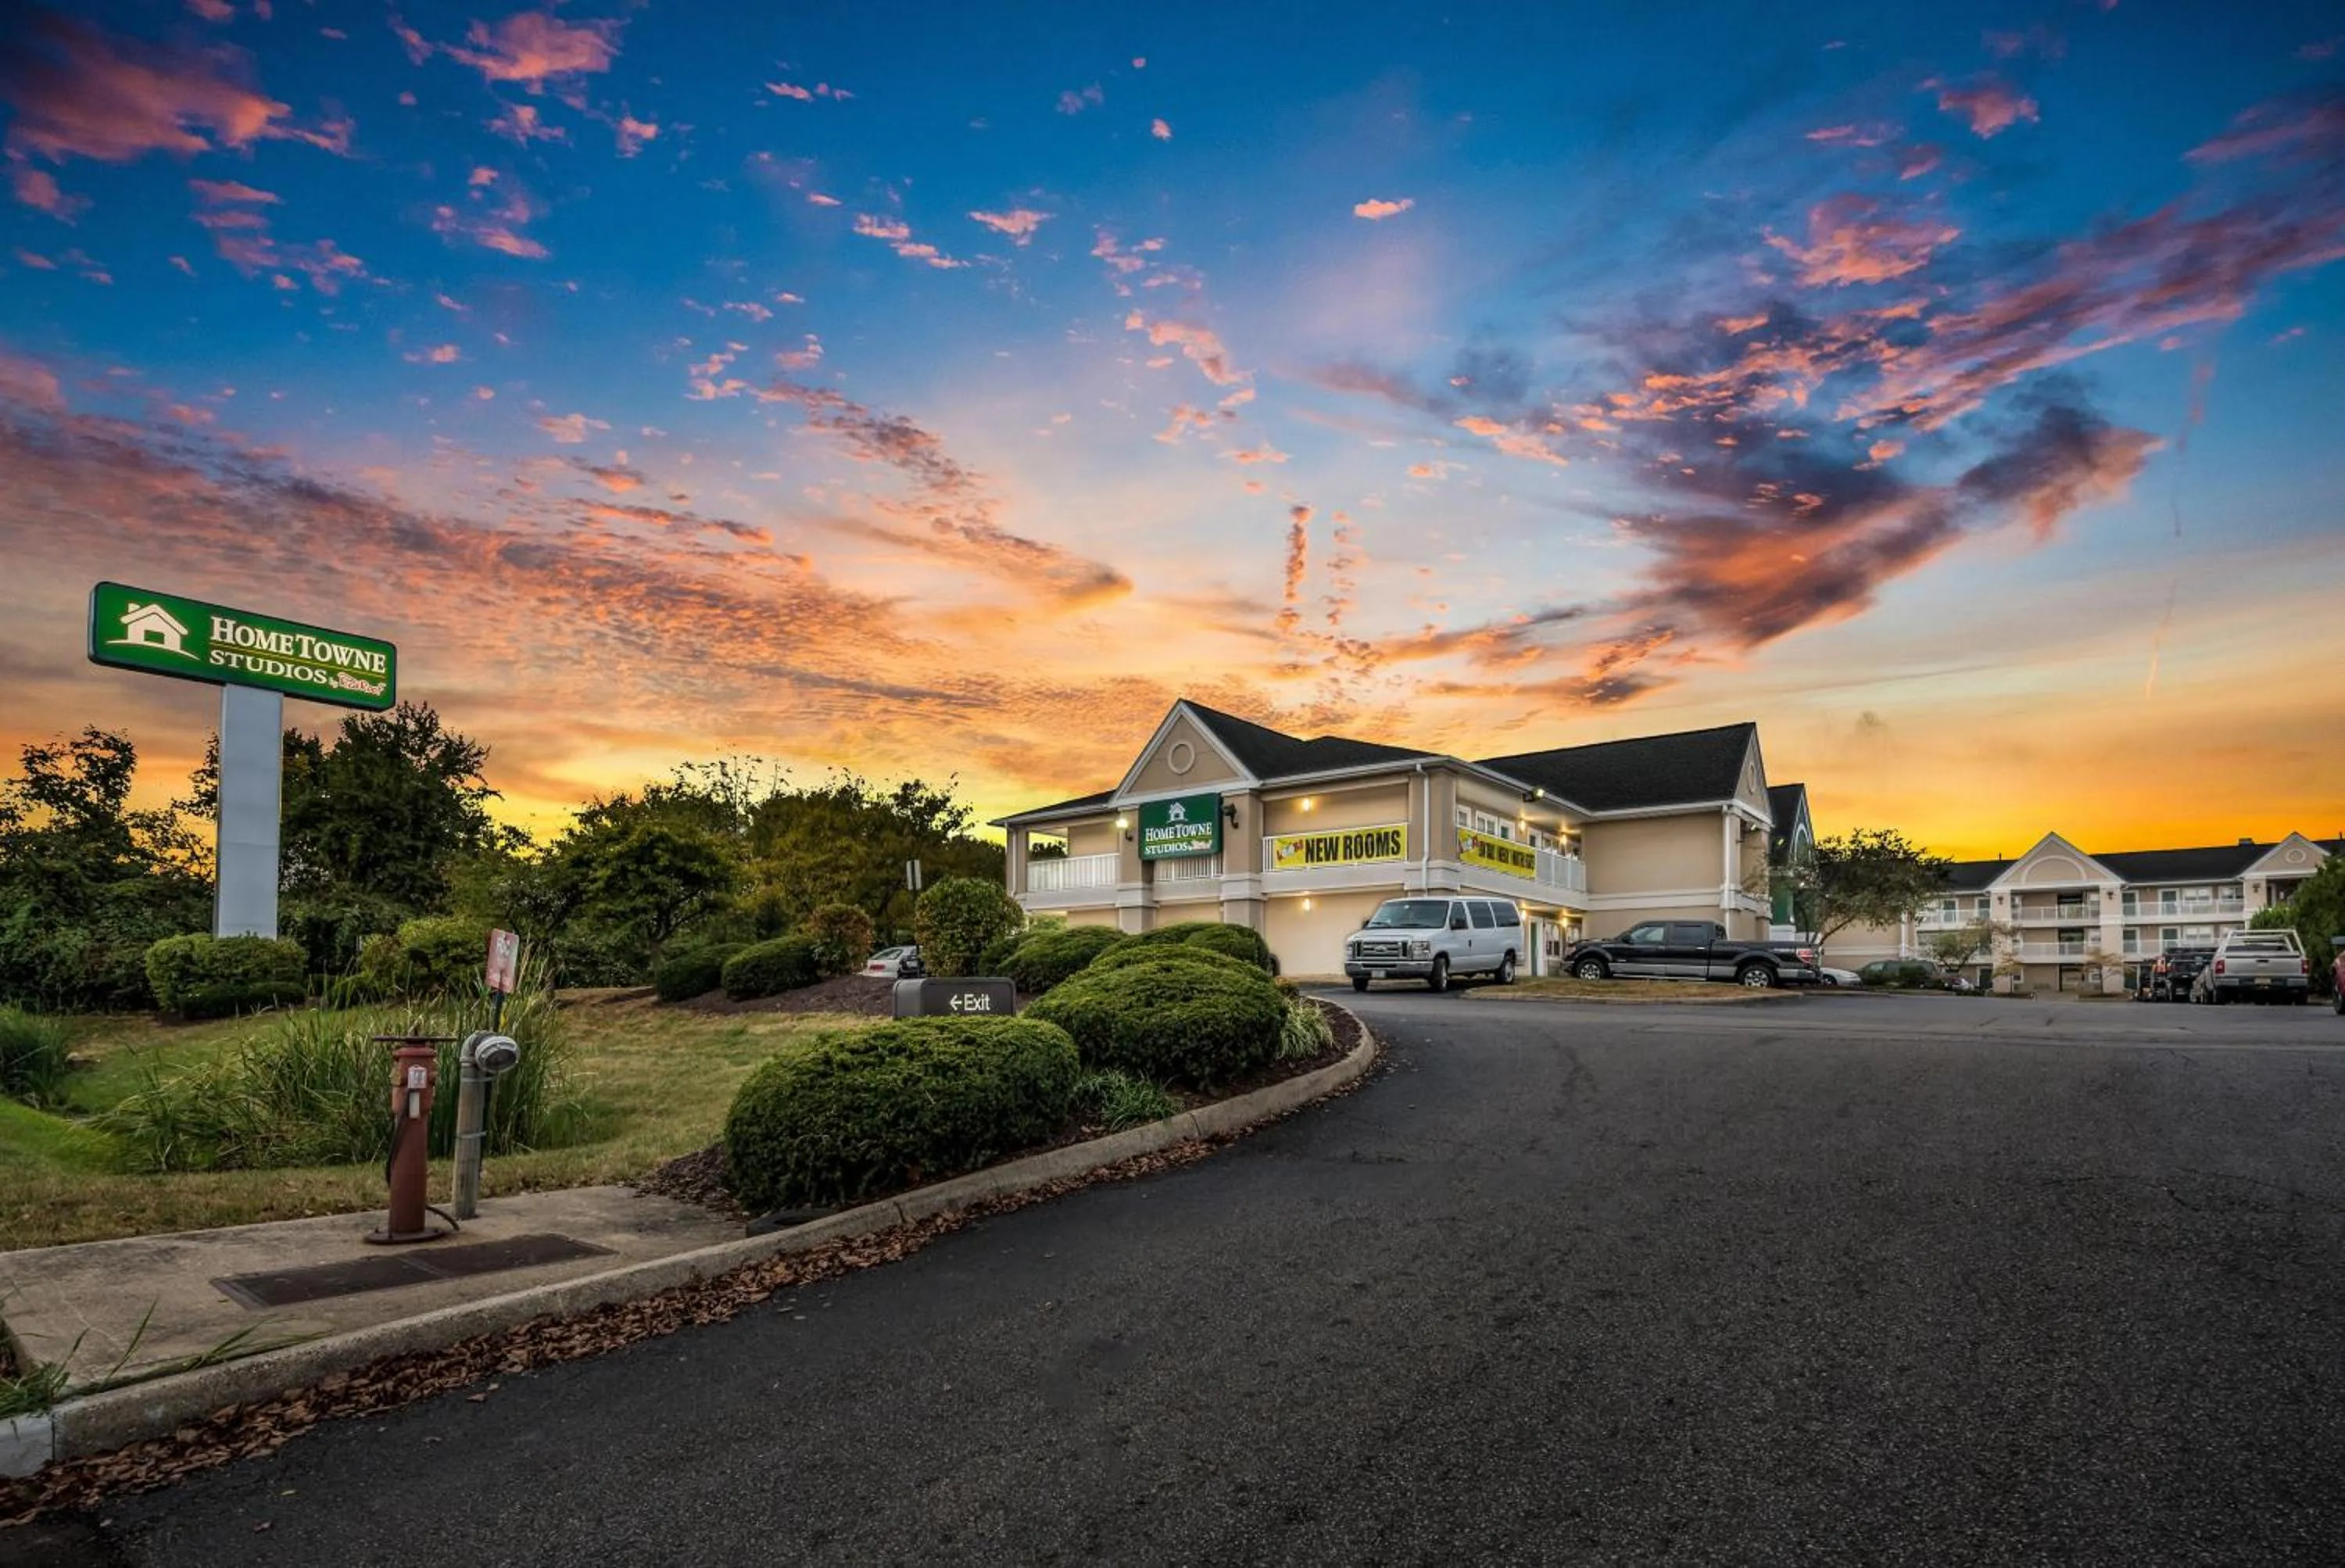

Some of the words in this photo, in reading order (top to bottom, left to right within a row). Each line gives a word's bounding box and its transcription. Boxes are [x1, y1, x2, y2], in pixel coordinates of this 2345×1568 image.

[209, 650, 328, 684] STUDIOS
[1144, 842, 1187, 854] STUDIOS
[1305, 836, 1341, 864] NEW
[1342, 829, 1402, 861] ROOMS
[964, 993, 991, 1011] Exit
